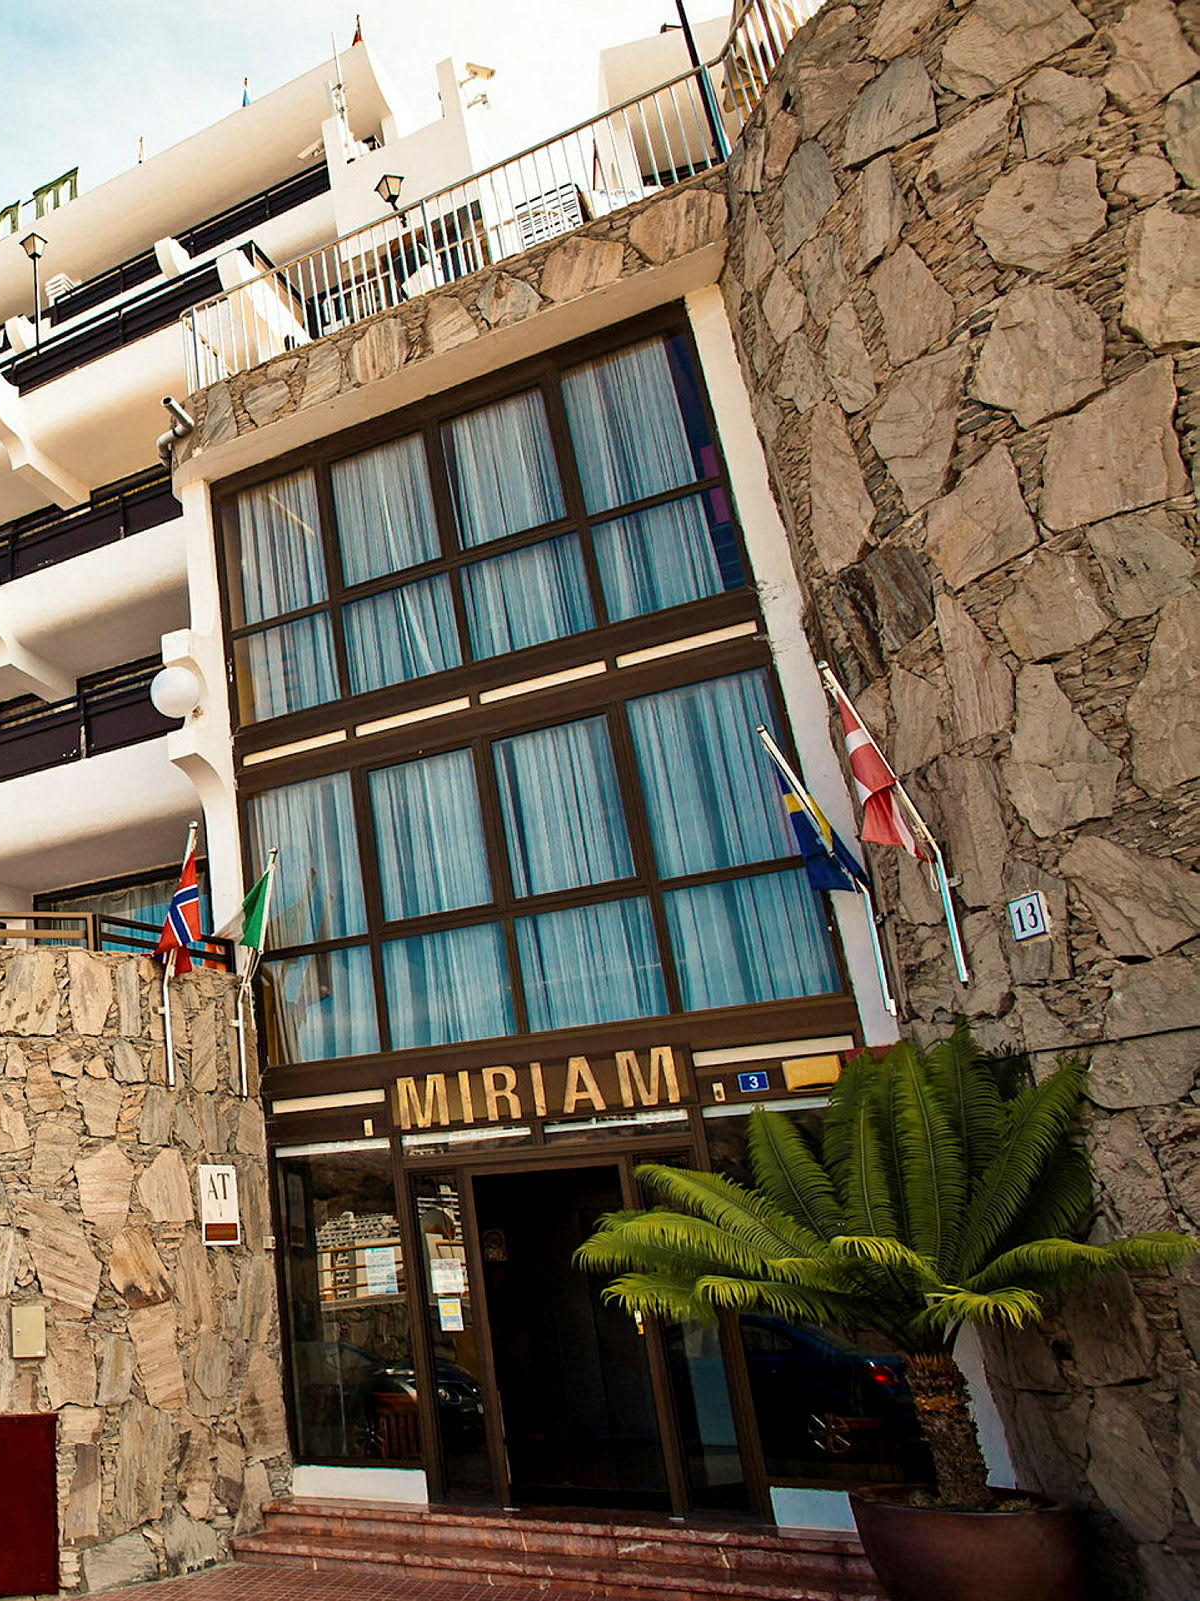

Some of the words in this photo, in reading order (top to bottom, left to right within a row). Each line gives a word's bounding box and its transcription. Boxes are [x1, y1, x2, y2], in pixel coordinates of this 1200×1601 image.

[1015, 902, 1038, 932] 13
[396, 1046, 680, 1130] MIRIAM
[749, 1076, 758, 1089] 3
[208, 1173, 230, 1200] AT
